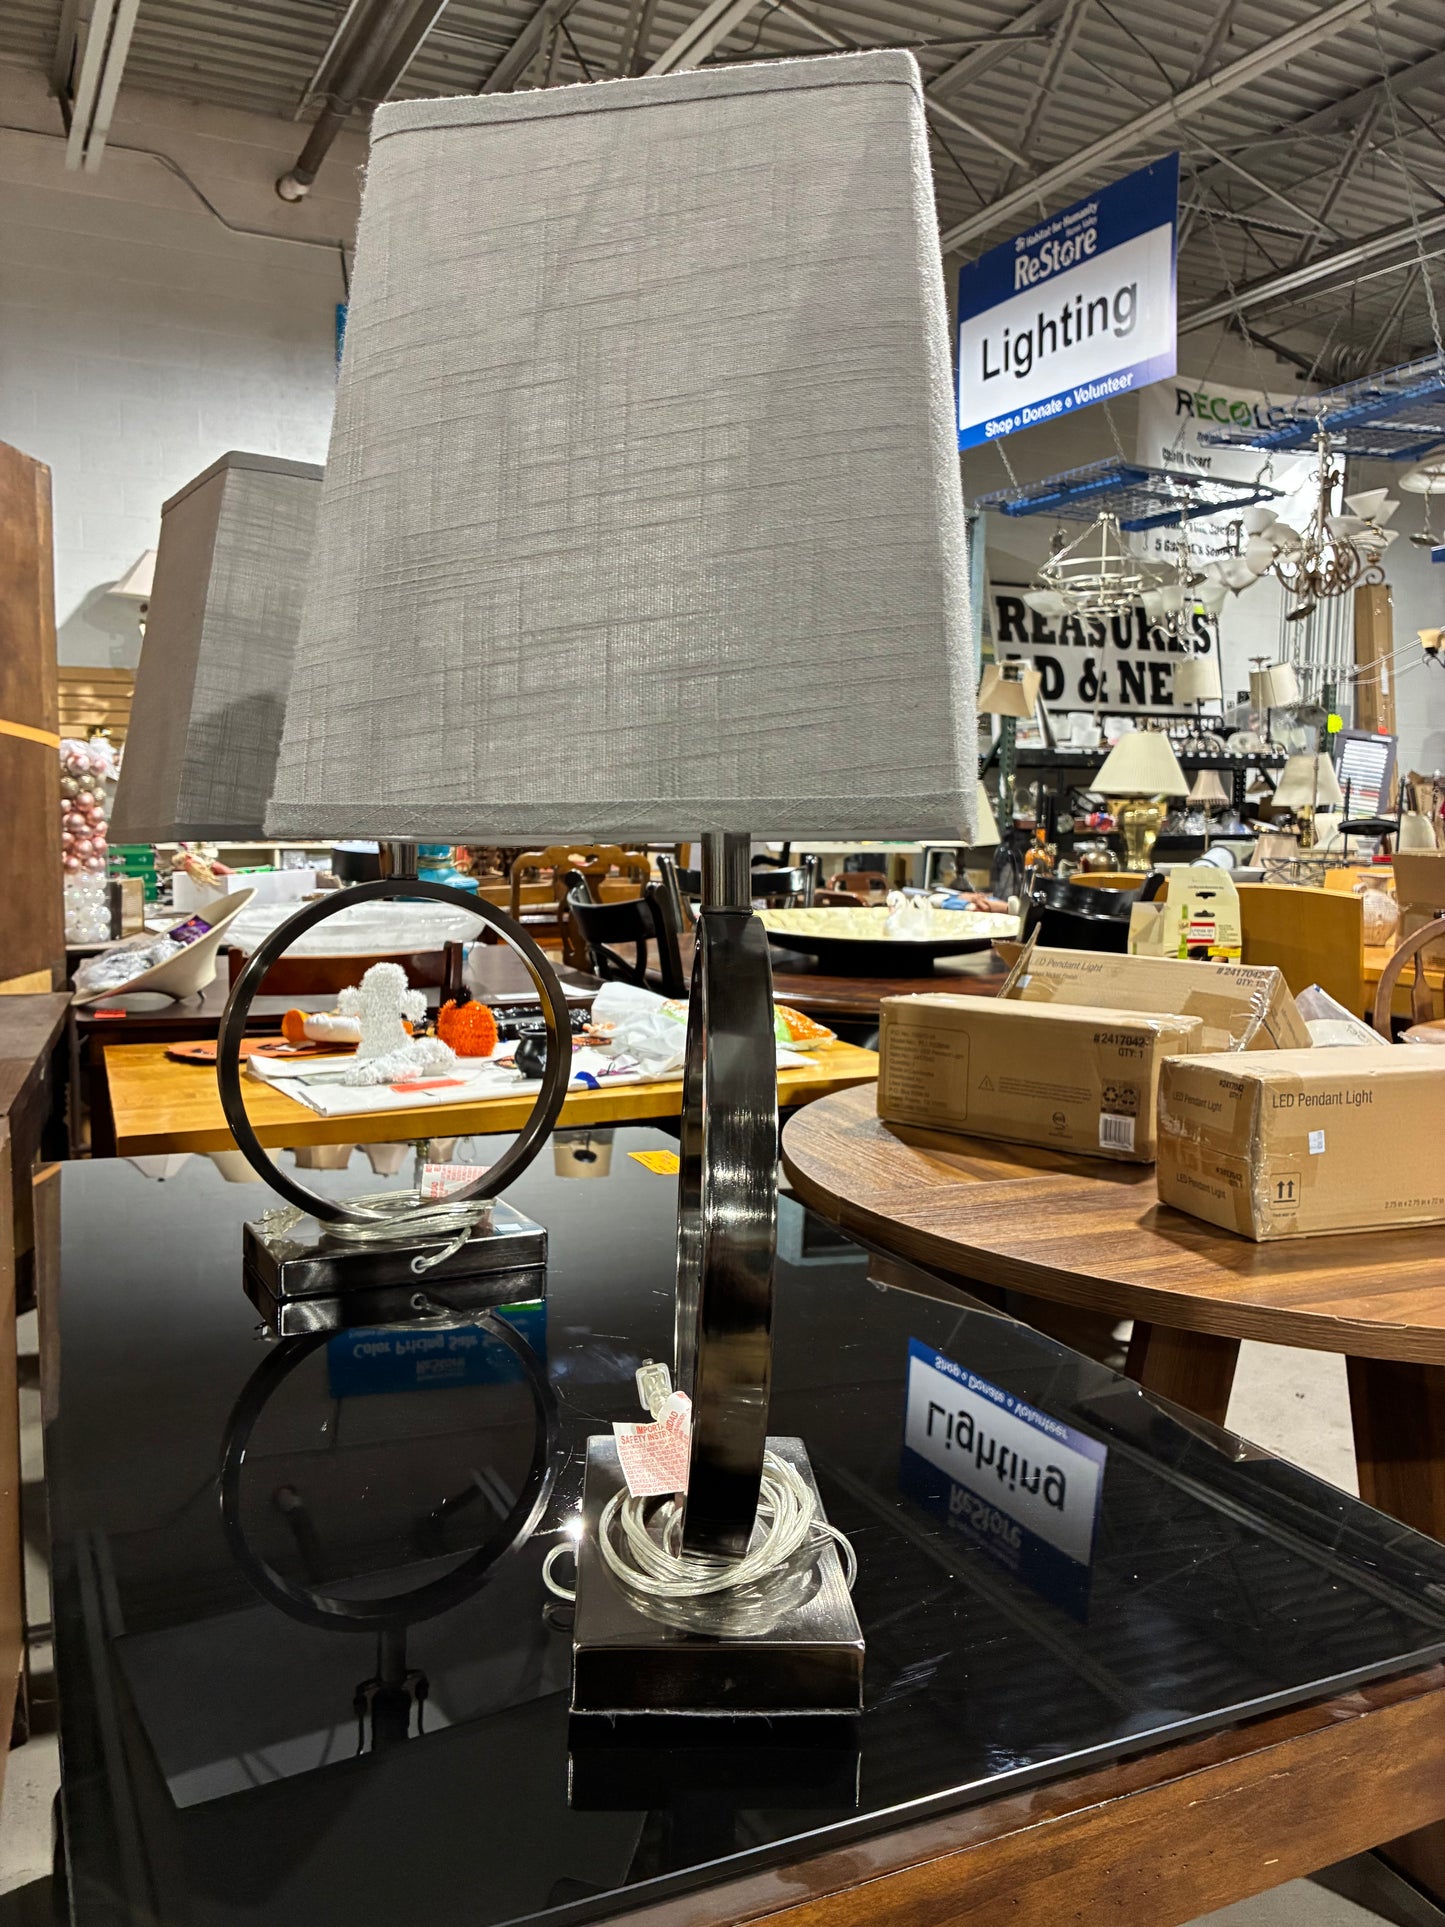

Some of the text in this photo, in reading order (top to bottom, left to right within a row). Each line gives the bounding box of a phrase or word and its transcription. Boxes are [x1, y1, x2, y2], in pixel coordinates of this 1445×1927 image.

[1014, 227, 1098, 291] ReStore
[982, 282, 1138, 382] Lighting
[985, 372, 1135, 439] Shop Donate Volunteer
[1077, 657, 1109, 703] &
[1117, 660, 1180, 706] NE
[1047, 958, 1080, 971] Pendant
[1081, 961, 1104, 974] Light
[1217, 966, 1265, 980] #2417042
[1094, 1032, 1146, 1048] #2417042
[1118, 1047, 1137, 1058] QTY:
[1173, 1090, 1223, 1113] LED Pendant Light
[1272, 1089, 1373, 1109] LED Pendant Light
[1176, 1172, 1188, 1185] LED
[1211, 1184, 1227, 1199] Light
[620, 1435, 646, 1445] SAFETY
